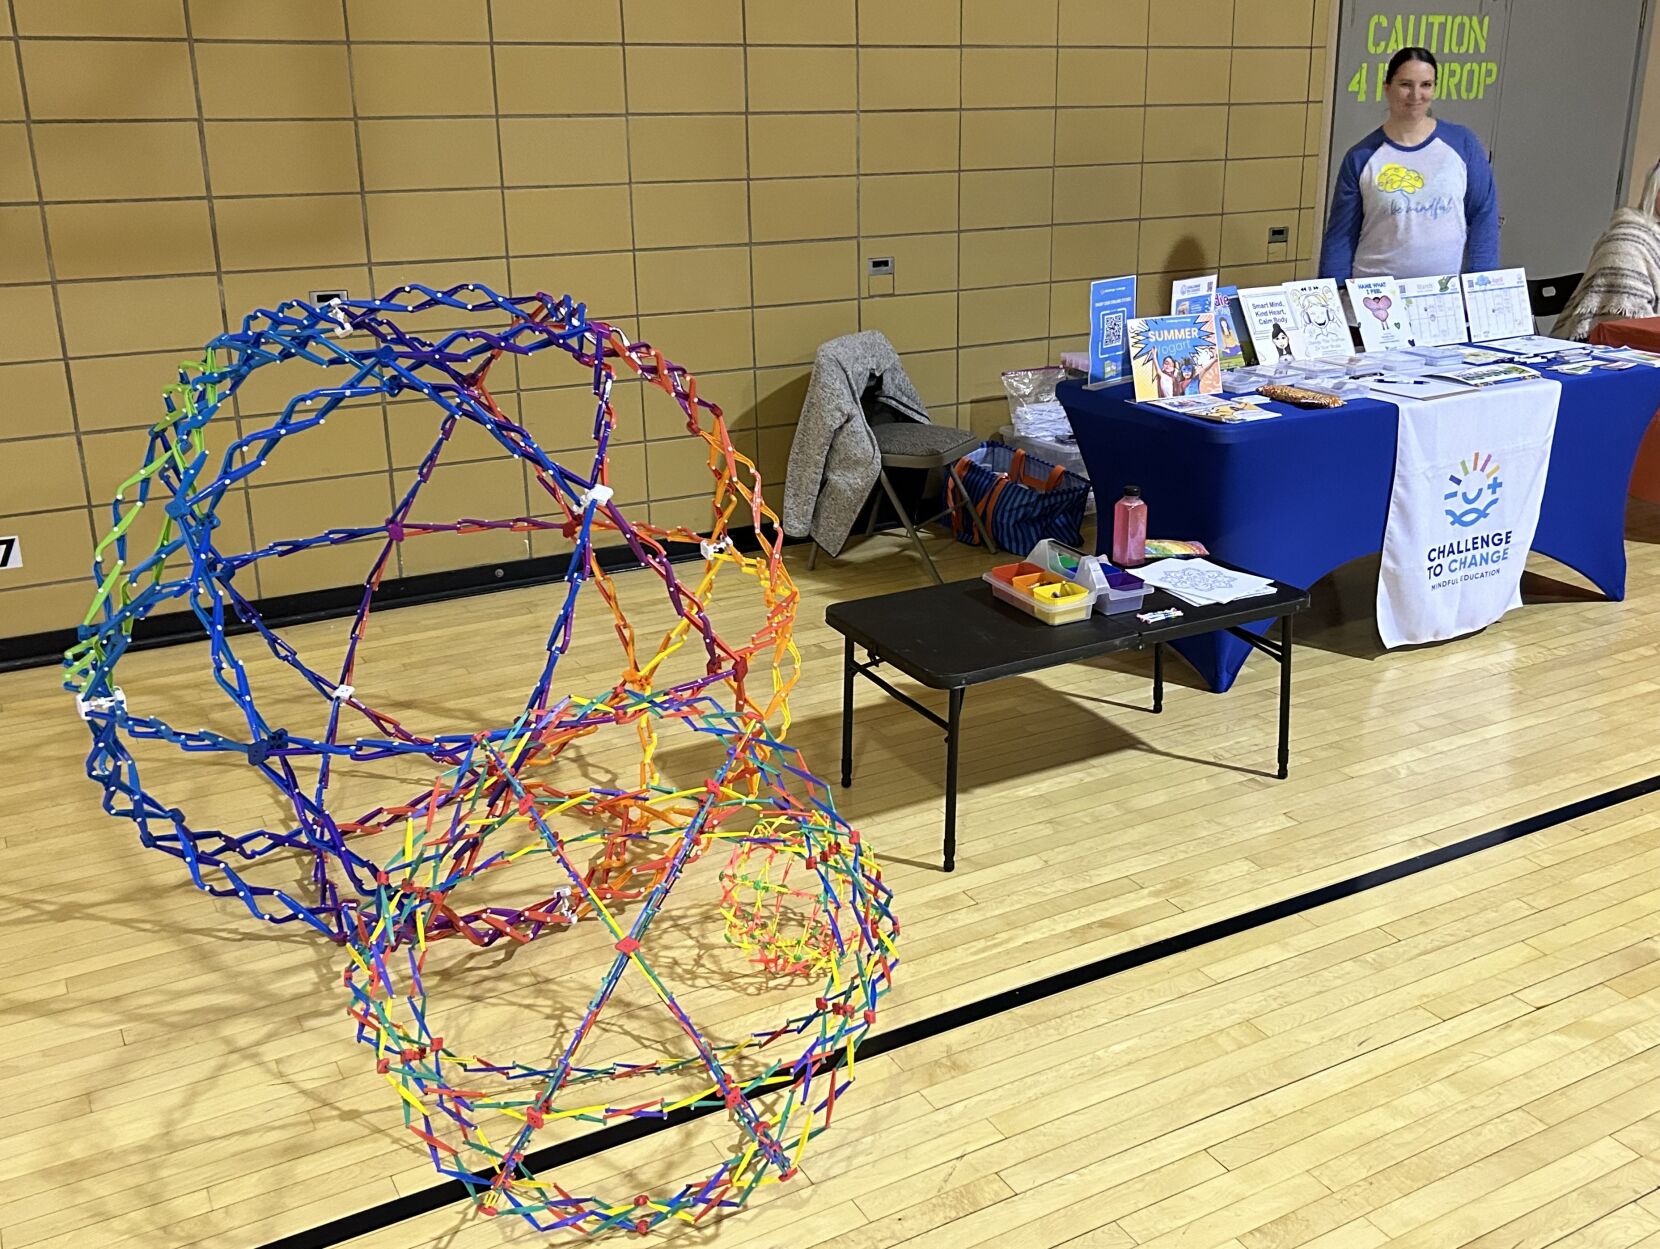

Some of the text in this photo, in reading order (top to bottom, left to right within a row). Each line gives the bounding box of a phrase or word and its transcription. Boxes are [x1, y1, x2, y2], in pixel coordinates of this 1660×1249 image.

[1367, 14, 1489, 54] CAUTION
[1348, 62, 1368, 102] 4
[1252, 302, 1269, 310] Smart
[1255, 310, 1269, 318] Kind
[1258, 316, 1288, 325] Calm Body
[1148, 327, 1199, 343] SUMMER
[1427, 530, 1512, 562] CHALLENGE
[1427, 547, 1509, 580] TO CHANGE
[1431, 568, 1501, 591] MINDFUL EDUCATION
